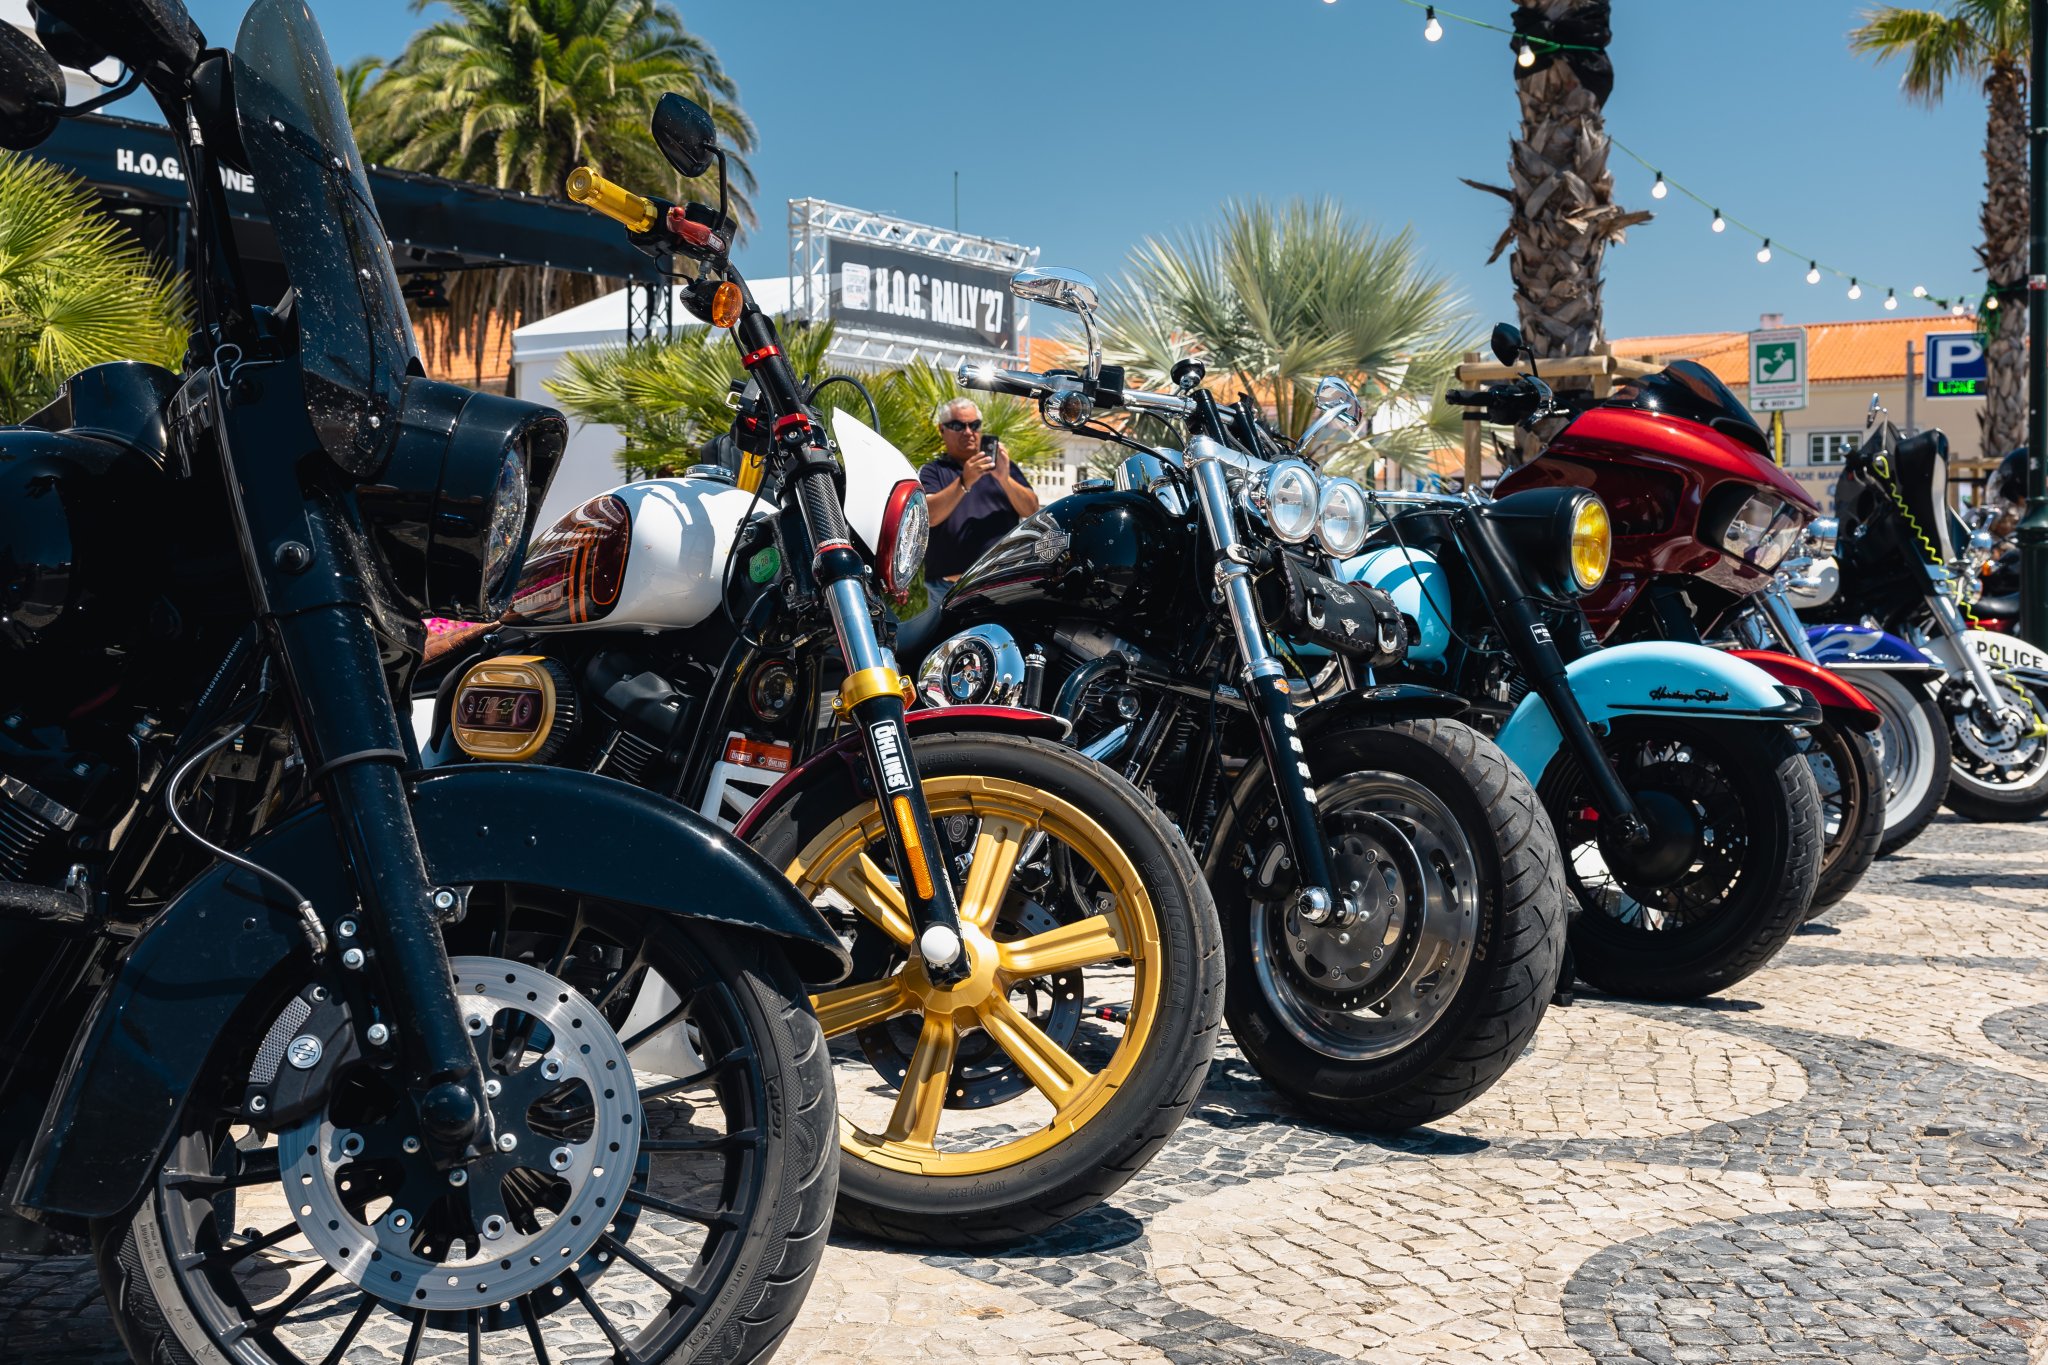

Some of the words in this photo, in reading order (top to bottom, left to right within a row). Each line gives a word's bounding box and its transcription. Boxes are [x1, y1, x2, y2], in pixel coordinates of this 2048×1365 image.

[117, 148, 186, 181] H.O.G.
[931, 278, 980, 330] RALLY
[1935, 339, 1984, 379] P
[1976, 640, 2044, 669] POLICE
[476, 696, 516, 715] 114
